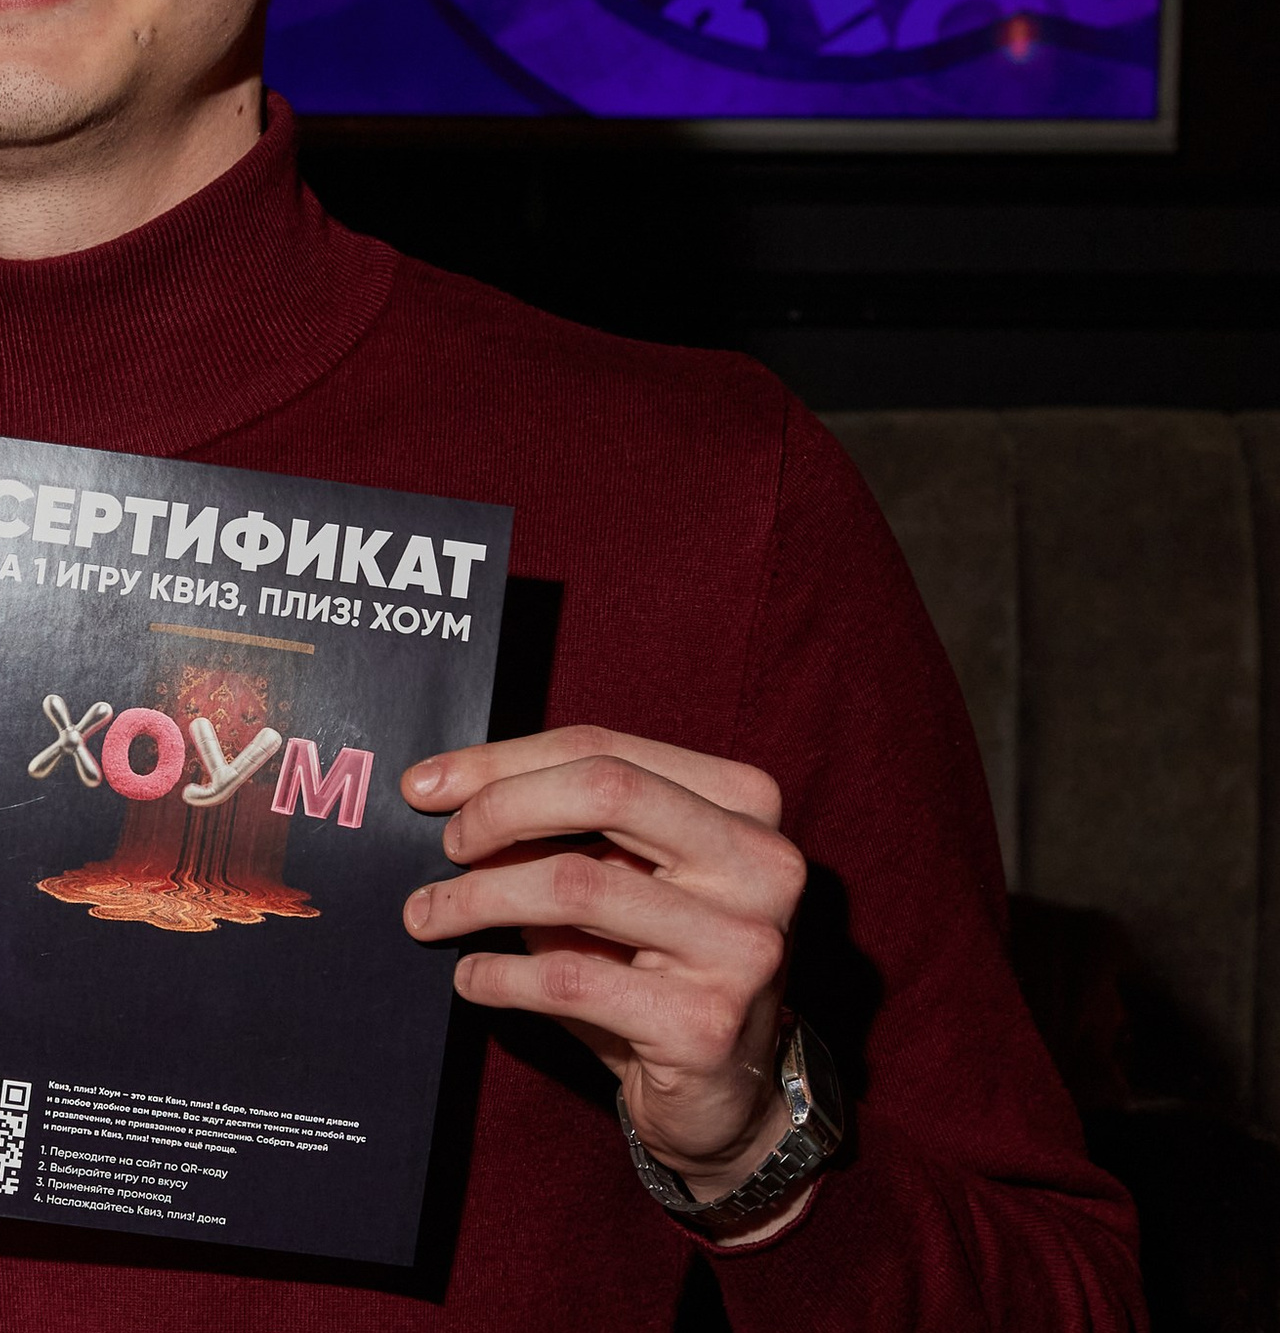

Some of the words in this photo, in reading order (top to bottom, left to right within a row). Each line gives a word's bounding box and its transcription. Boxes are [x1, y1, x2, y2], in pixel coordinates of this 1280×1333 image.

[33, 557, 46, 585] 1
[56, 562, 143, 597] ИГРУ
[149, 573, 248, 618] КВИЗ,
[258, 587, 361, 628] ПЛИЗ!
[369, 602, 472, 643] ХОУМ
[27, 693, 375, 830] ХОУМ
[48, 1080, 72, 1093] Квиз,
[73, 1085, 98, 1095] плиз!
[98, 1087, 122, 1099] Хоум
[130, 1093, 147, 1102] это
[147, 1095, 165, 1104] как
[165, 1095, 189, 1108] Квиз,
[190, 1100, 215, 1110] плиз!
[214, 1103, 221, 1111] в
[221, 1103, 248, 1116] баре,
[249, 1108, 280, 1119] только
[280, 1112, 294, 1120] на
[294, 1114, 326, 1124] вашем
[325, 1118, 361, 1129] диване
[61, 1098, 92, 1108] любое
[92, 1102, 132, 1114] удобное
[132, 1107, 151, 1116] вам
[151, 1109, 182, 1120] время.
[182, 1111, 201, 1123] Вас
[201, 1116, 226, 1126] ждут
[225, 1119, 262, 1130] десятки
[263, 1123, 301, 1135] тематик
[301, 1129, 314, 1137] на
[314, 1130, 346, 1141] любой
[346, 1134, 367, 1144] вкус
[43, 1123, 50, 1131] и
[50, 1124, 93, 1136] поиграть
[93, 1129, 101, 1137] в
[101, 1129, 125, 1141] Квиз,
[125, 1133, 150, 1143] плиз!
[151, 1136, 183, 1148] теперь
[183, 1141, 204, 1151] ещё
[204, 1143, 238, 1155] проще.
[44, 1109, 52, 1117] и
[52, 1110, 114, 1126] развлечение,
[114, 1119, 128, 1127] не
[128, 1120, 187, 1135] привязанное
[195, 1129, 255, 1143] расписанию.
[256, 1135, 296, 1148] Собрать
[296, 1142, 329, 1152] друзей
[37, 1160, 48, 1172] 2.
[50, 1162, 113, 1180] Выбирайте
[114, 1172, 140, 1185] игру
[141, 1175, 157, 1185] по
[157, 1178, 189, 1191] вкусу
[40, 1145, 48, 1156] 1.
[50, 1146, 118, 1165] Переходите
[118, 1157, 134, 1167] на
[135, 1159, 163, 1170] сайт
[164, 1162, 179, 1172] по
[180, 1162, 229, 1180] QR-коду
[33, 1192, 44, 1204] 4.
[46, 1194, 135, 1215] Наслаждайтесь
[136, 1205, 165, 1220] Квиз,
[167, 1210, 196, 1222] плиз!
[196, 1214, 227, 1226] дома
[35, 1176, 46, 1188] 3.
[47, 1178, 116, 1197] Применяйте
[117, 1189, 173, 1205] промокод
